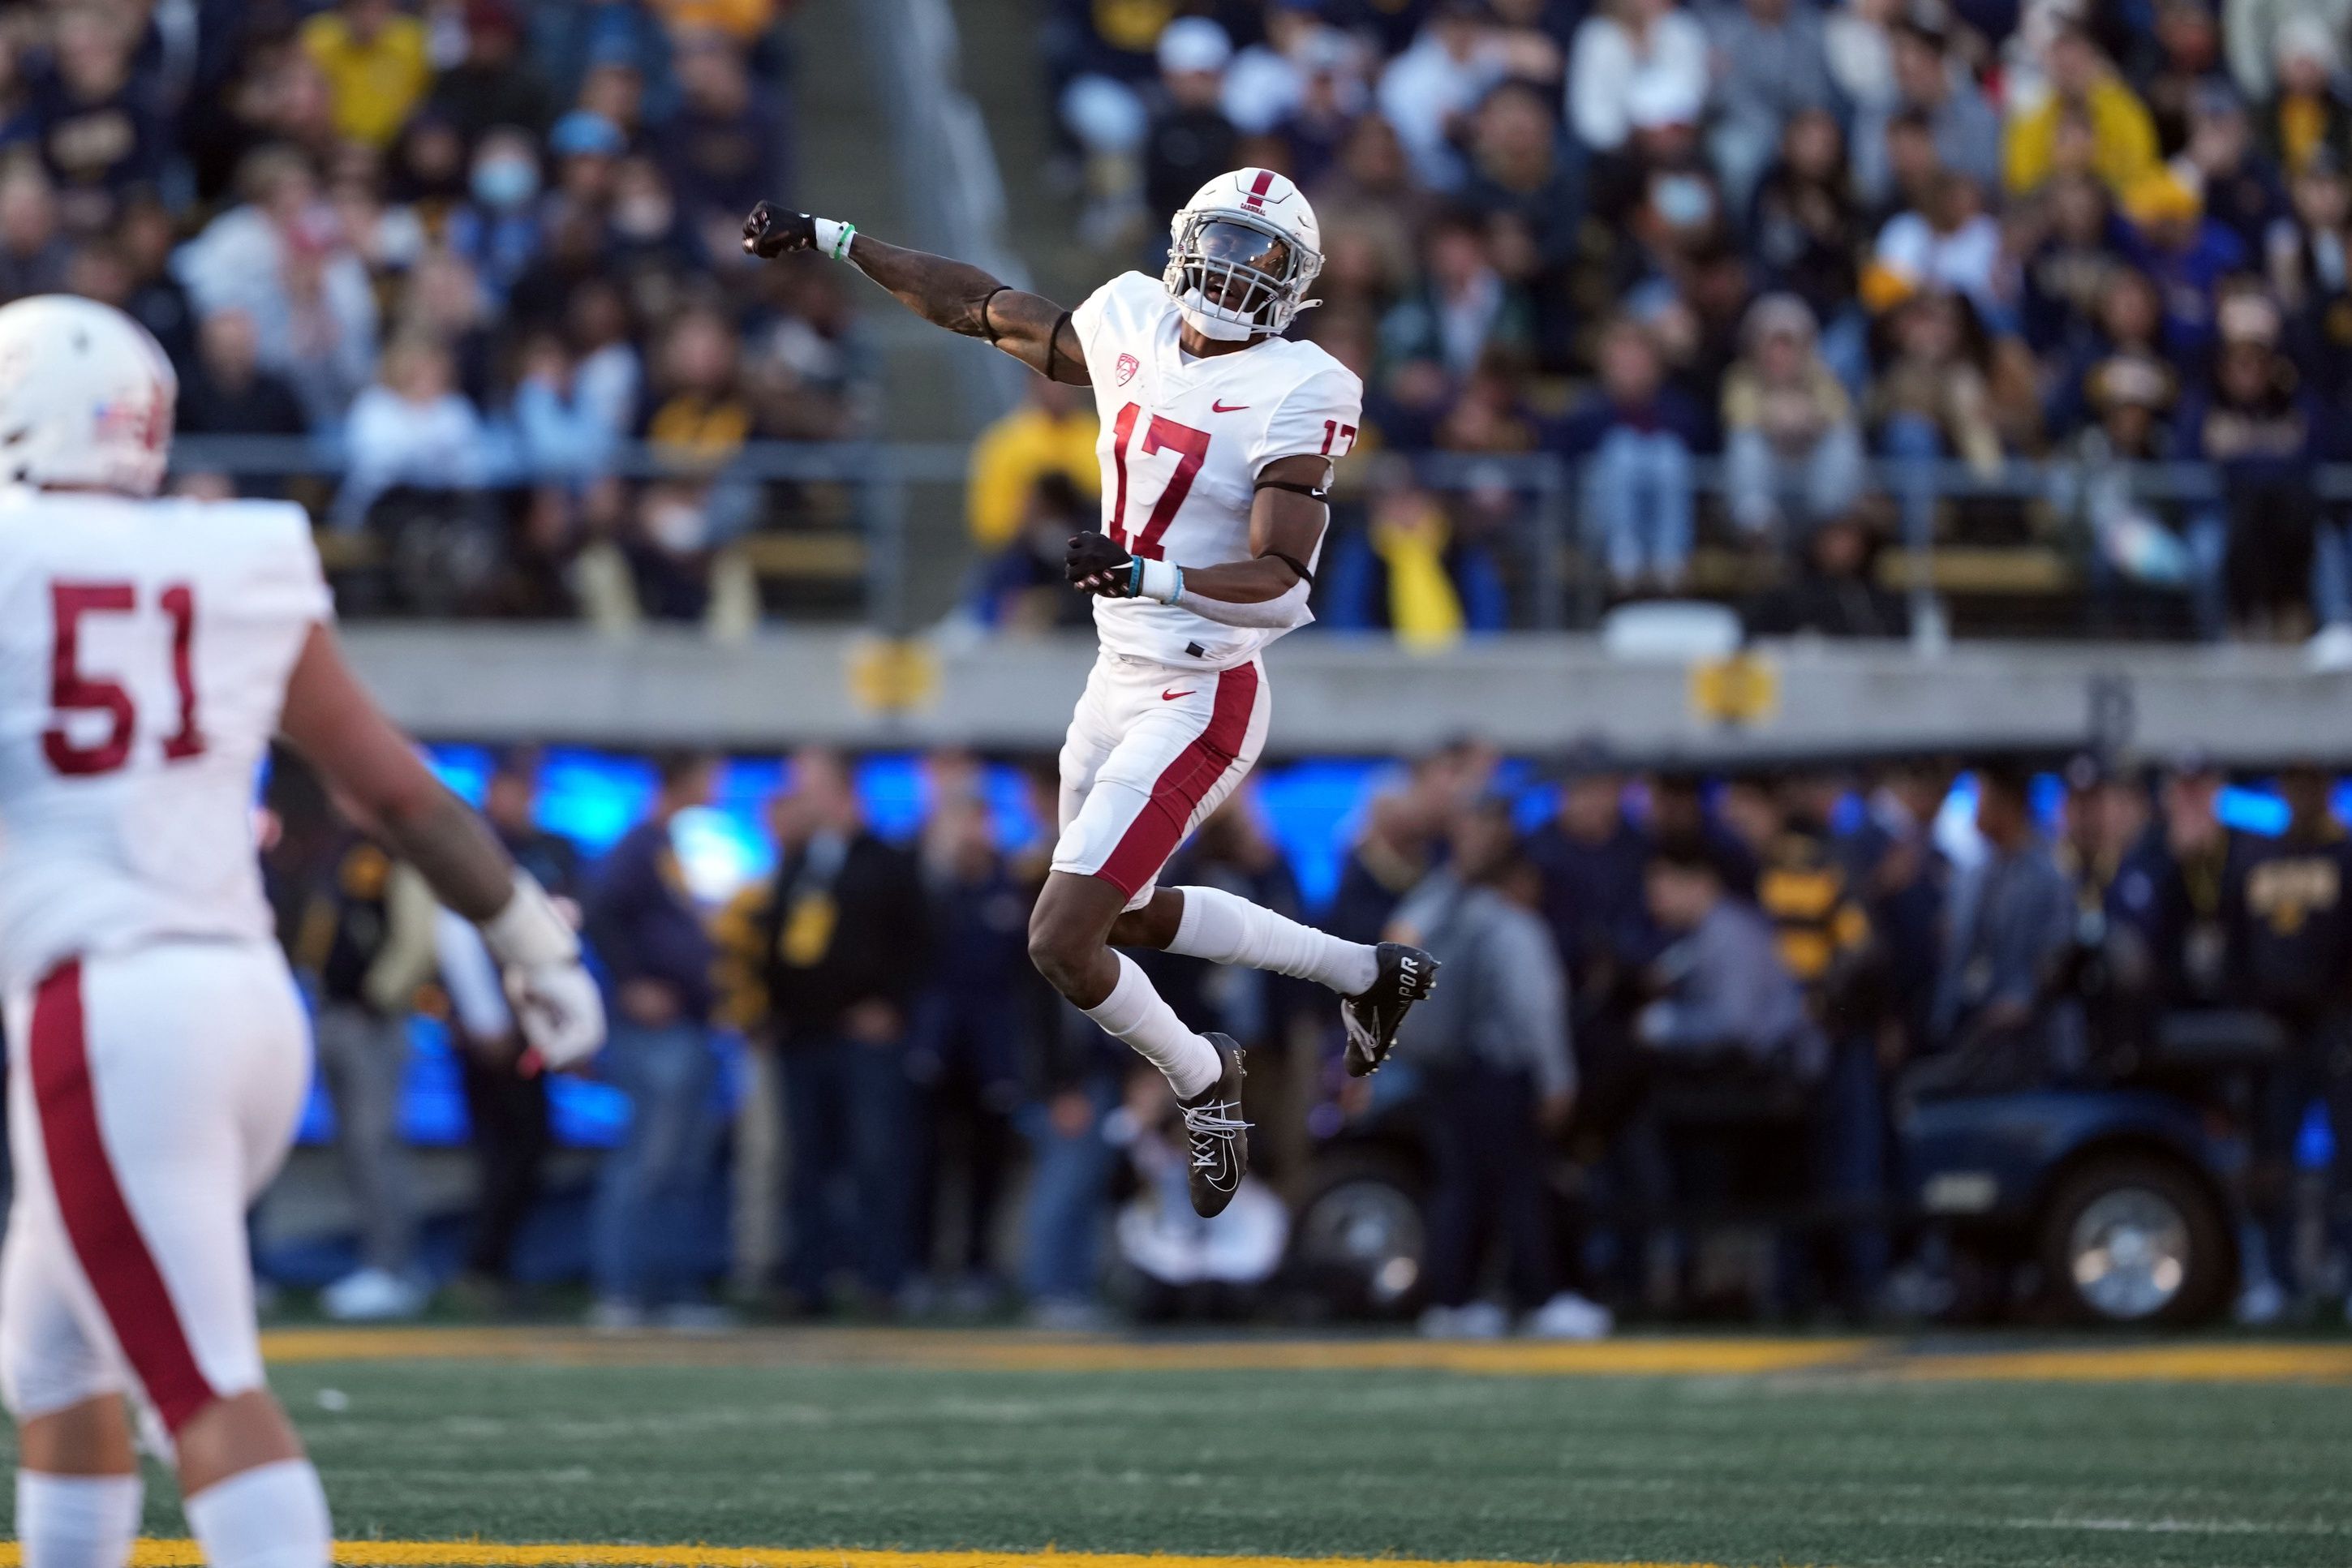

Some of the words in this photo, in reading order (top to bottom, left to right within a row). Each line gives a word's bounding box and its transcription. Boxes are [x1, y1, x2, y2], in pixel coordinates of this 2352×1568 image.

[1109, 401, 1211, 562] 17
[1320, 419, 1357, 455] 17
[41, 583, 207, 775] 51
